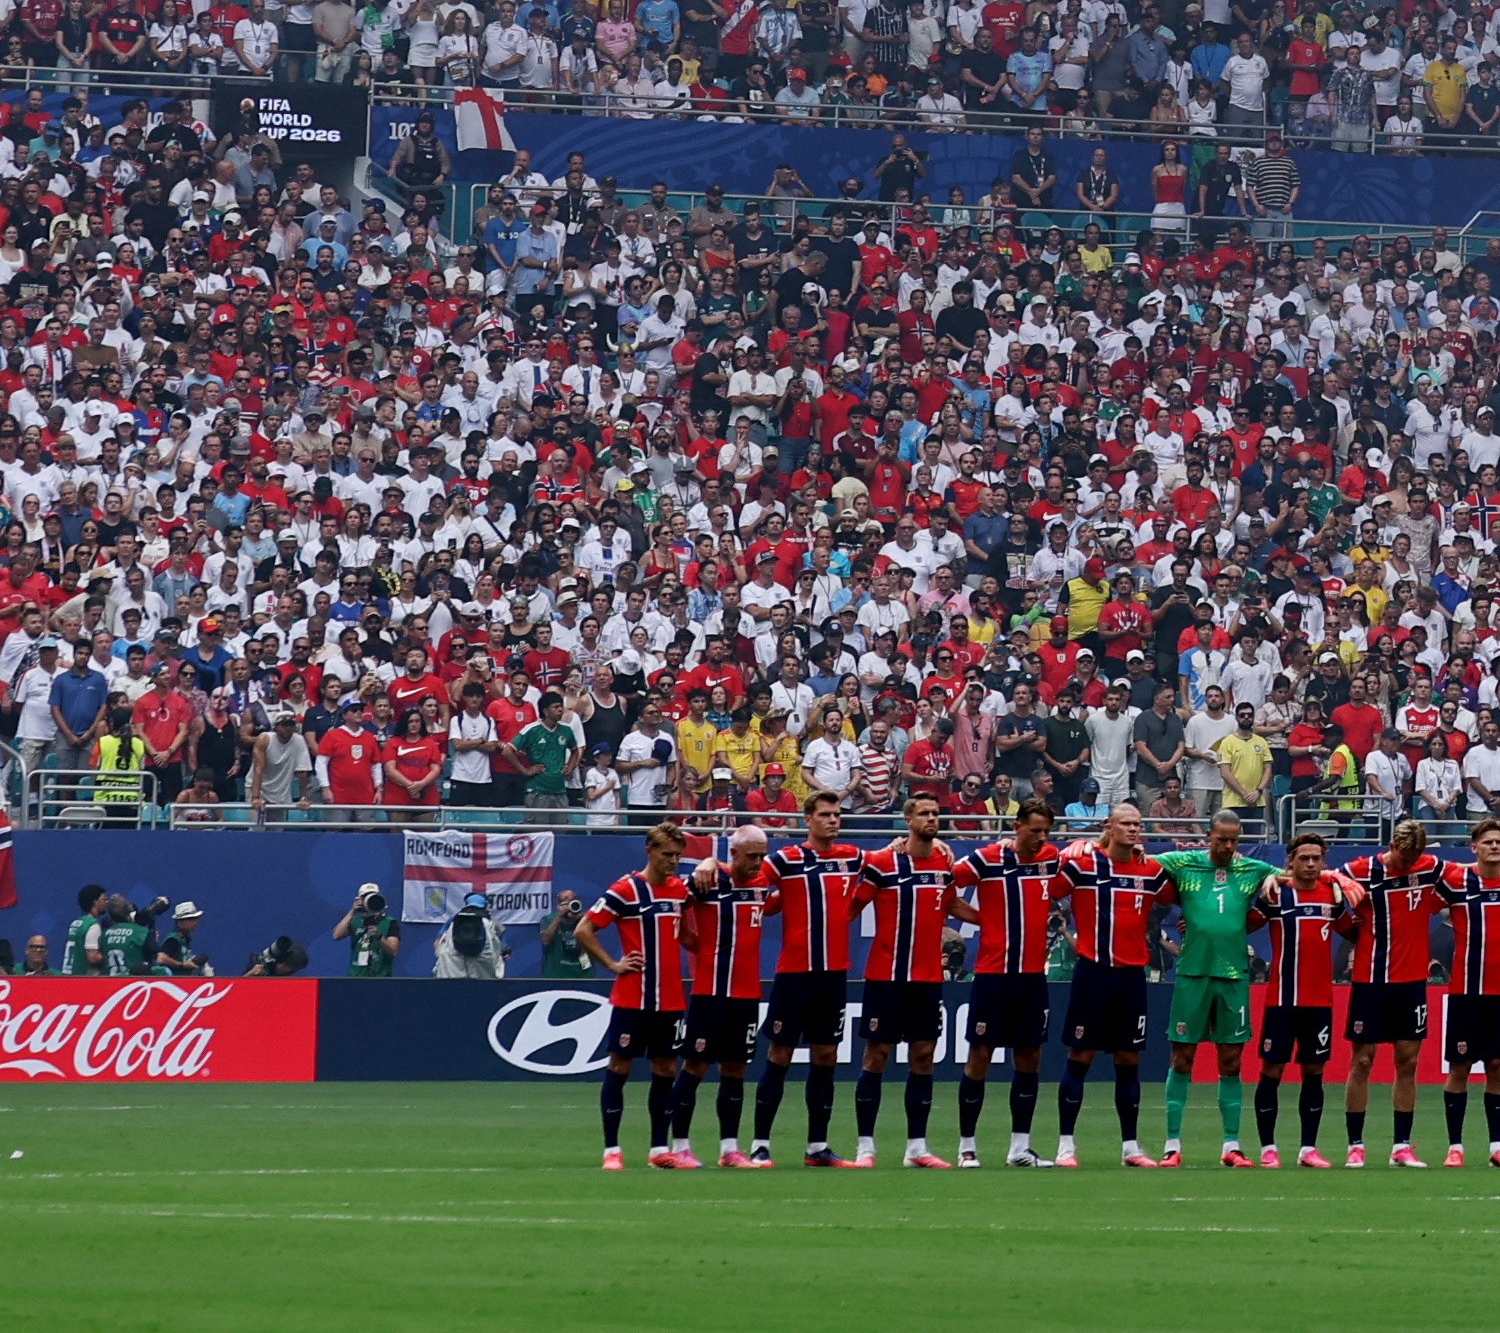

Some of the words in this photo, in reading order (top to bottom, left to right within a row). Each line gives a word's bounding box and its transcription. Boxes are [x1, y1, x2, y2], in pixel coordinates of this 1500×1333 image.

[259, 98, 291, 112] FIFA
[259, 113, 312, 126] WORLD
[287, 129, 341, 142] 2026
[407, 838, 471, 859] ROMFORD
[488, 892, 549, 910] TORONTO
[1134, 894, 1143, 915] 9
[1217, 893, 1225, 914] 1
[1406, 889, 1422, 912] 17
[1321, 921, 1329, 942] 6
[1138, 1015, 1147, 1036] 9
[1238, 1006, 1245, 1027] 1
[1415, 1005, 1428, 1028] 17
[0, 980, 234, 1077] ca-Cola
[1317, 1025, 1328, 1046] 6
